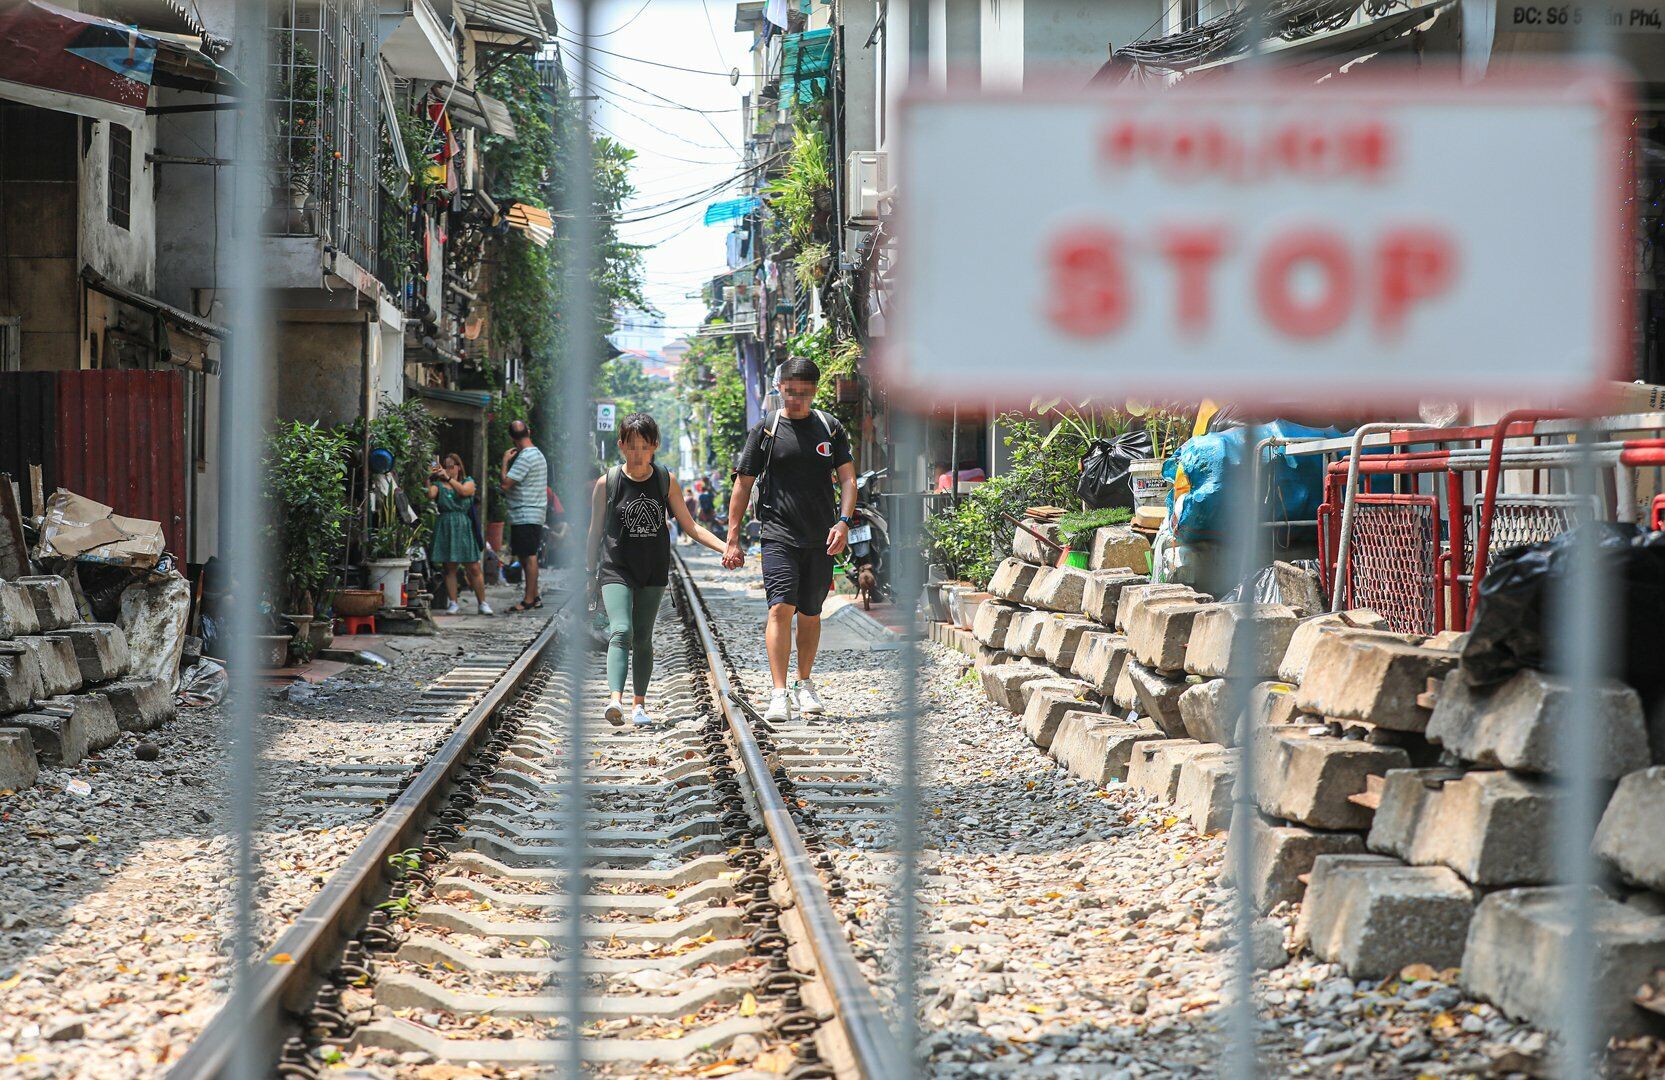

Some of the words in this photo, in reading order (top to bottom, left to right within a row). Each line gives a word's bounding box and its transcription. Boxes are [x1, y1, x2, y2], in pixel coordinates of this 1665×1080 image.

[1513, 6, 1542, 25] ĐC:
[1547, 4, 1569, 25] Số
[1044, 225, 1458, 341] STOP
